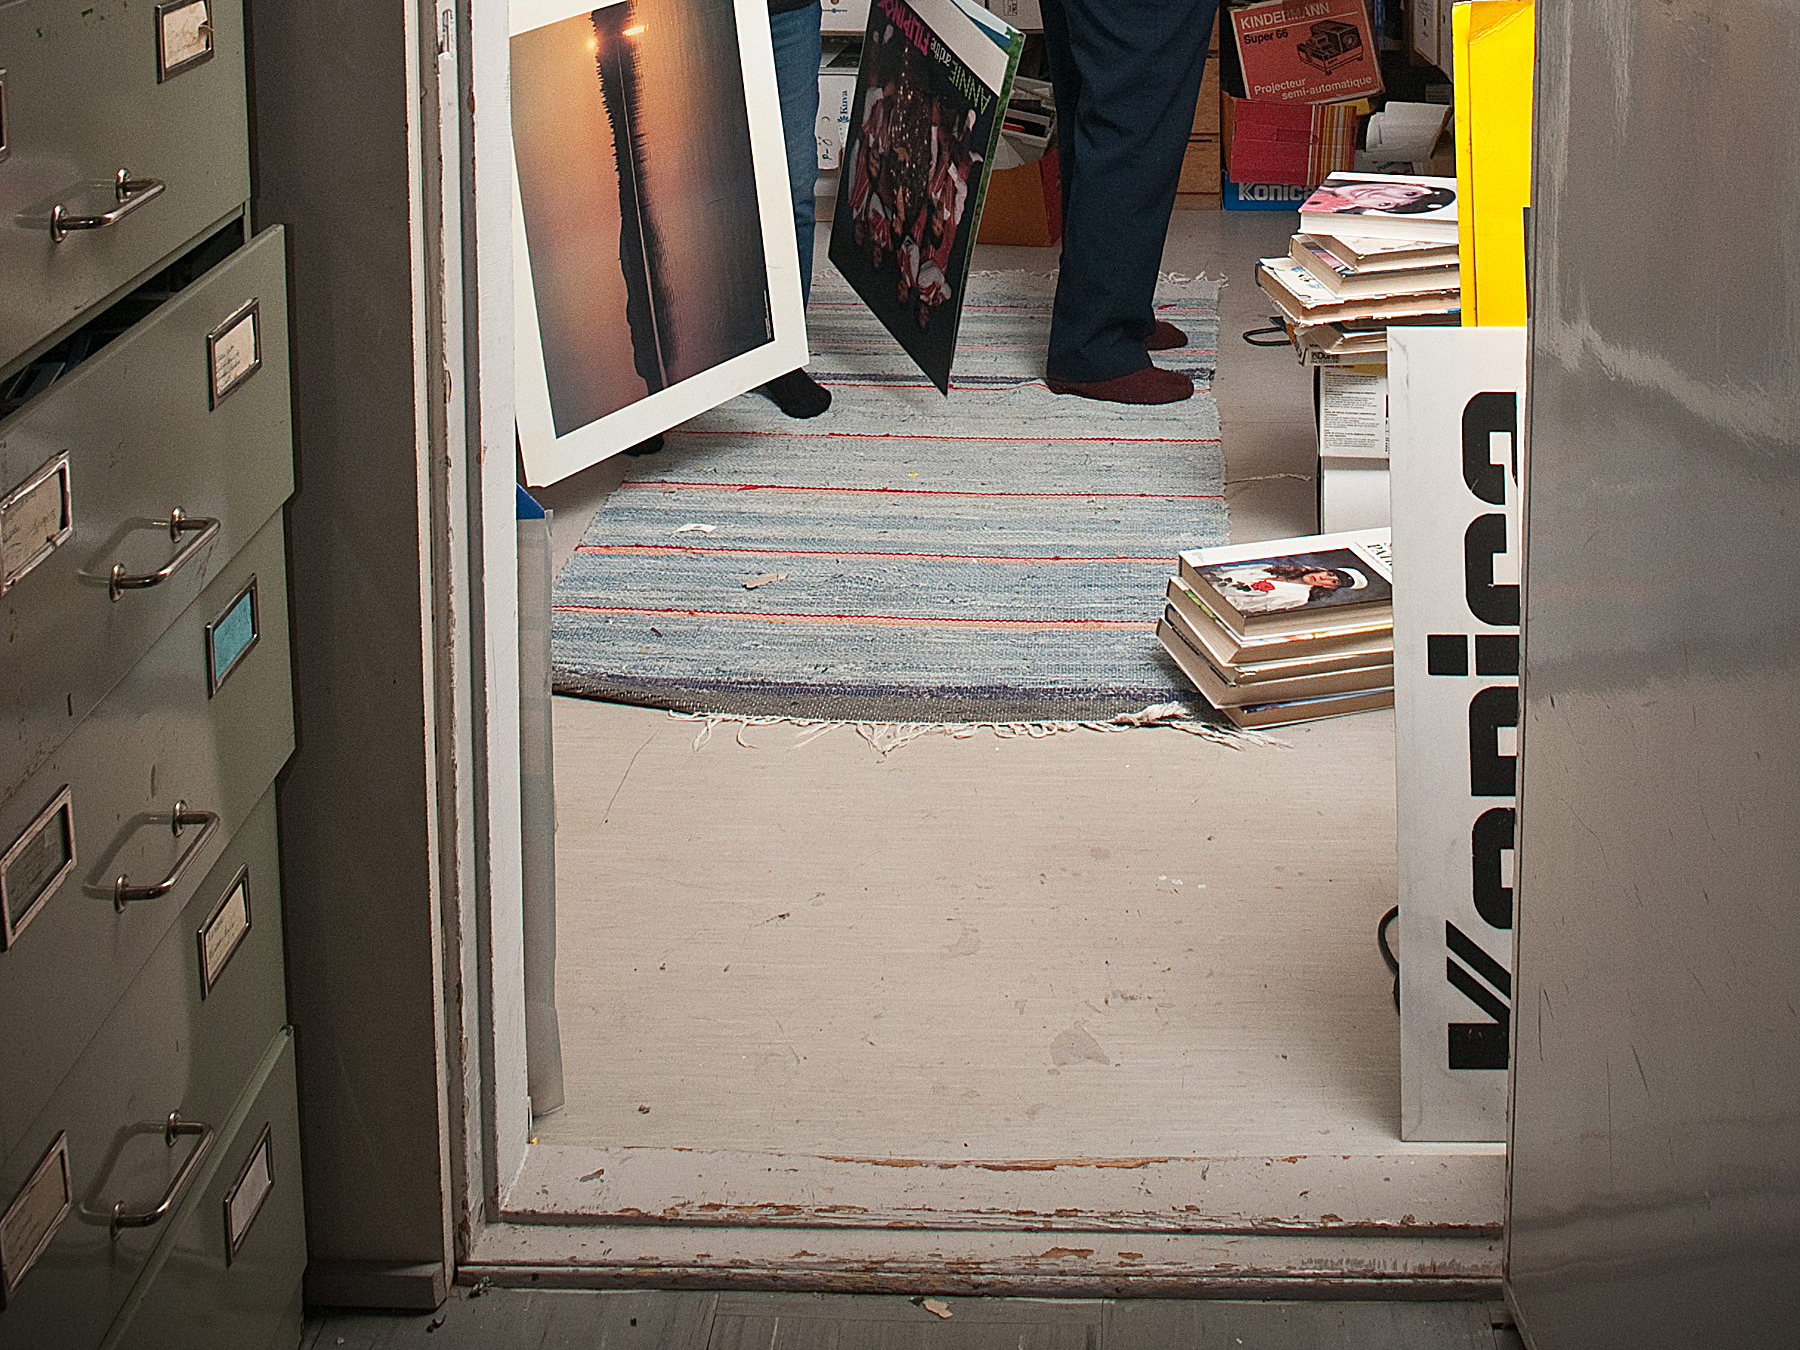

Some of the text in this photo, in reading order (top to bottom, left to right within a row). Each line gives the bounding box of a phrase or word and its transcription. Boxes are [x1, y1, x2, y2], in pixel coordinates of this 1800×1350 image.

[1243, 28, 1289, 44] Super 66
[948, 60, 992, 115] ANNIE
[1254, 78, 1306, 95] Projecteur
[1282, 75, 1373, 100] semi-automatique
